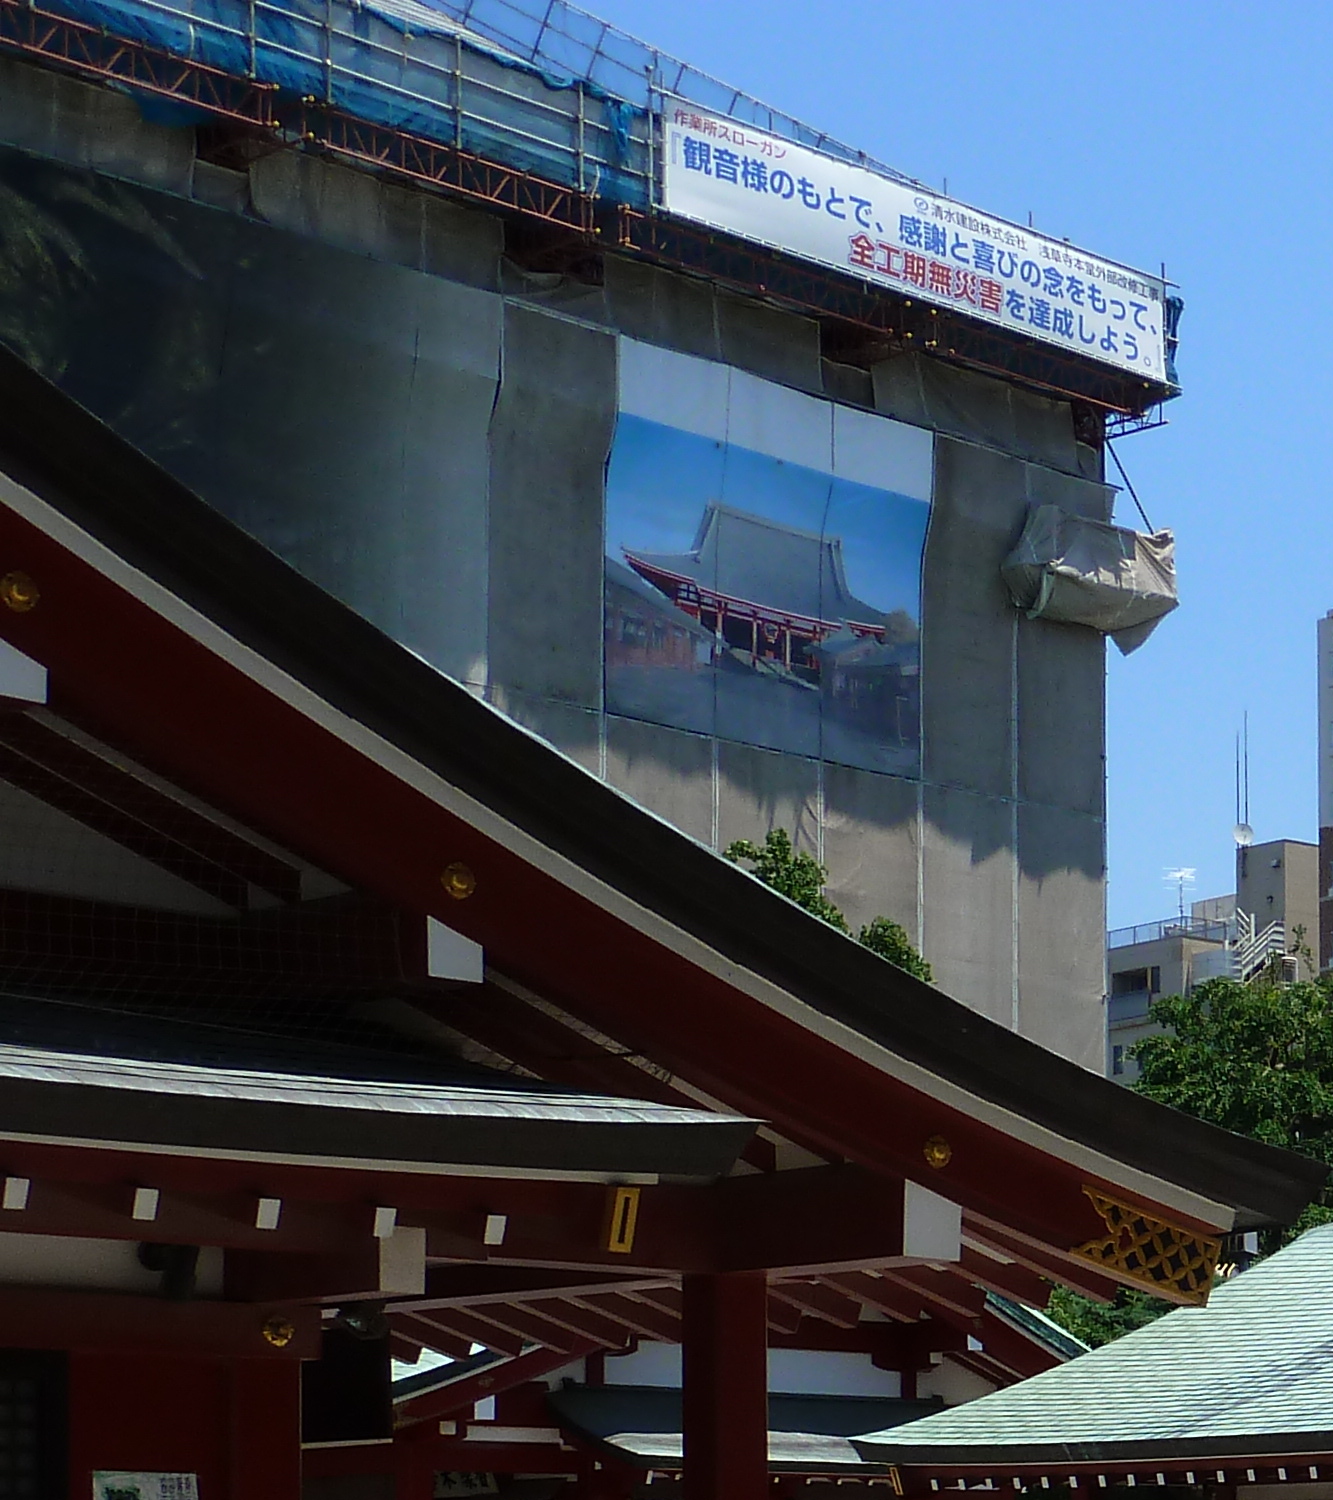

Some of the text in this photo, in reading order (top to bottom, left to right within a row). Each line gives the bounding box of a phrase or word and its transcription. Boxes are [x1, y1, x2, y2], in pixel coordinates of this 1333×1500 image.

[674, 108, 787, 159] 作業所スローガン
[931, 202, 1028, 250] 清水建設株式会社
